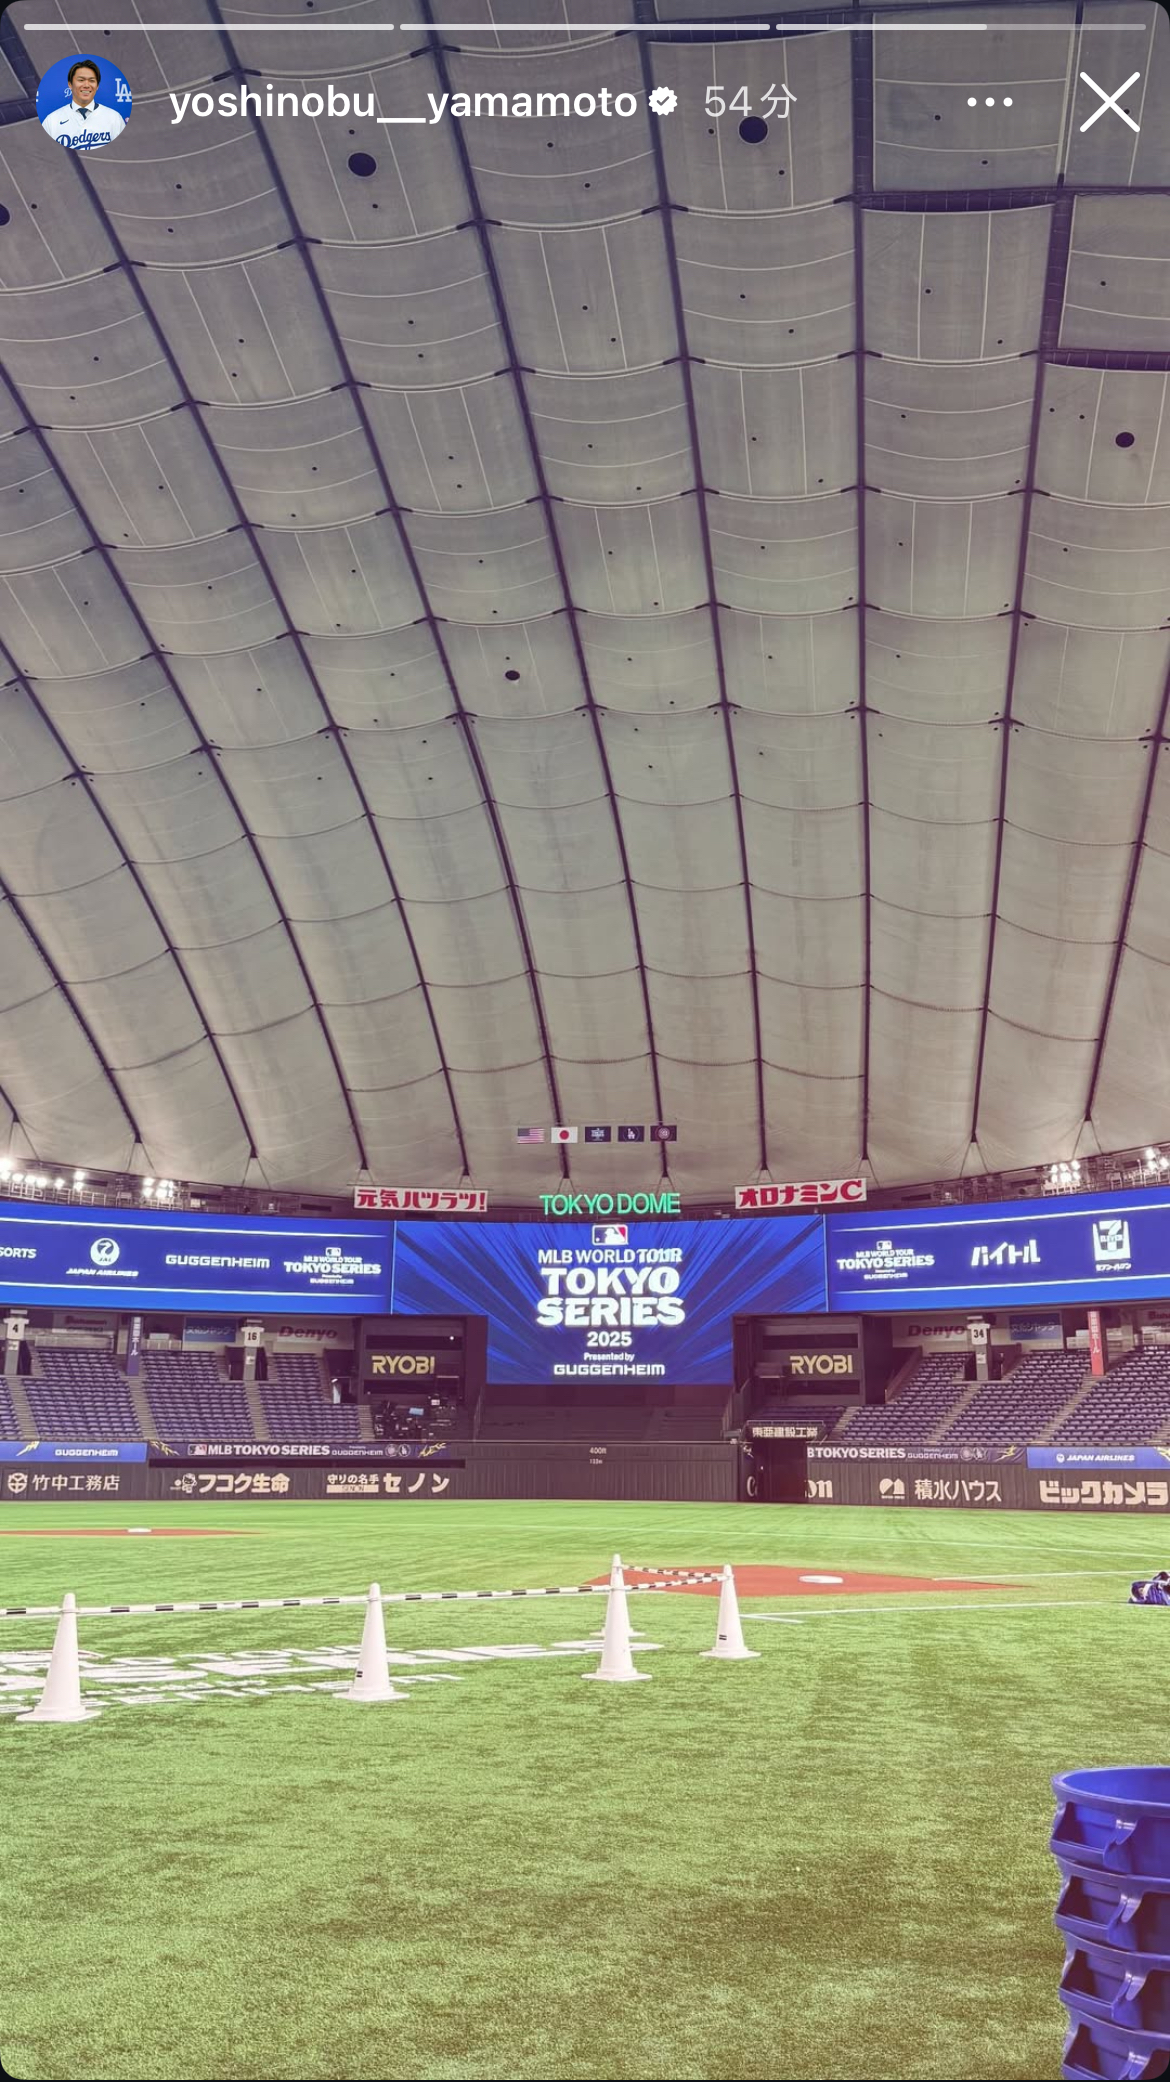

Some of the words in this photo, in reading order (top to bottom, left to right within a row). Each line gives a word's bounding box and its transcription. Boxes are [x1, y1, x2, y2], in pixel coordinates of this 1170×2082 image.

[357, 1188, 486, 1210] 元気ハツラツ!
[739, 1180, 863, 1207] オロナミンC
[539, 1193, 614, 1215] TOKYO
[617, 1193, 681, 1214] DOME
[538, 1249, 573, 1264] MLB
[575, 1249, 636, 1264] WORLD
[636, 1248, 683, 1263] TOUR
[871, 1250, 895, 1258] WORLD
[896, 1248, 914, 1256] TOUR
[165, 1254, 270, 1269] GUGGENHEIM
[283, 1261, 331, 1273] TOKYO
[331, 1263, 382, 1274] SERIES
[836, 1258, 883, 1270] TOKYO
[884, 1255, 935, 1267] SERIES
[540, 1266, 680, 1295] TOKYO
[536, 1296, 686, 1326] SERIES
[12, 1323, 18, 1333] 4
[279, 1325, 338, 1341] Denyo
[908, 1324, 966, 1339] Denyo
[973, 1328, 985, 1339] 34
[247, 1332, 257, 1341] 16
[586, 1331, 633, 1347] 2025
[371, 1355, 436, 1374] RYOBI
[583, 1352, 625, 1361] Presented
[625, 1352, 635, 1362] by
[789, 1354, 853, 1375] RYOBI
[553, 1364, 666, 1376] GUGGENHEIM
[55, 1449, 118, 1457] GUGGENHEIM
[208, 1445, 232, 1456] MLB
[234, 1445, 281, 1456] TOKYO
[281, 1445, 330, 1456] SERIES
[815, 1447, 859, 1459] TOKYO
[860, 1447, 906, 1459] SERIES
[1066, 1454, 1095, 1462] JAPAN
[1095, 1454, 1136, 1462] AIRLINES
[32, 1474, 120, 1492] 竹中工務店
[198, 1472, 291, 1494] フコク生命
[327, 1473, 380, 1485] 守りの名手
[383, 1472, 450, 1494] セノン
[914, 1479, 1002, 1502] 積水ハウス
[1039, 1480, 1169, 1506] ビックカメラ
